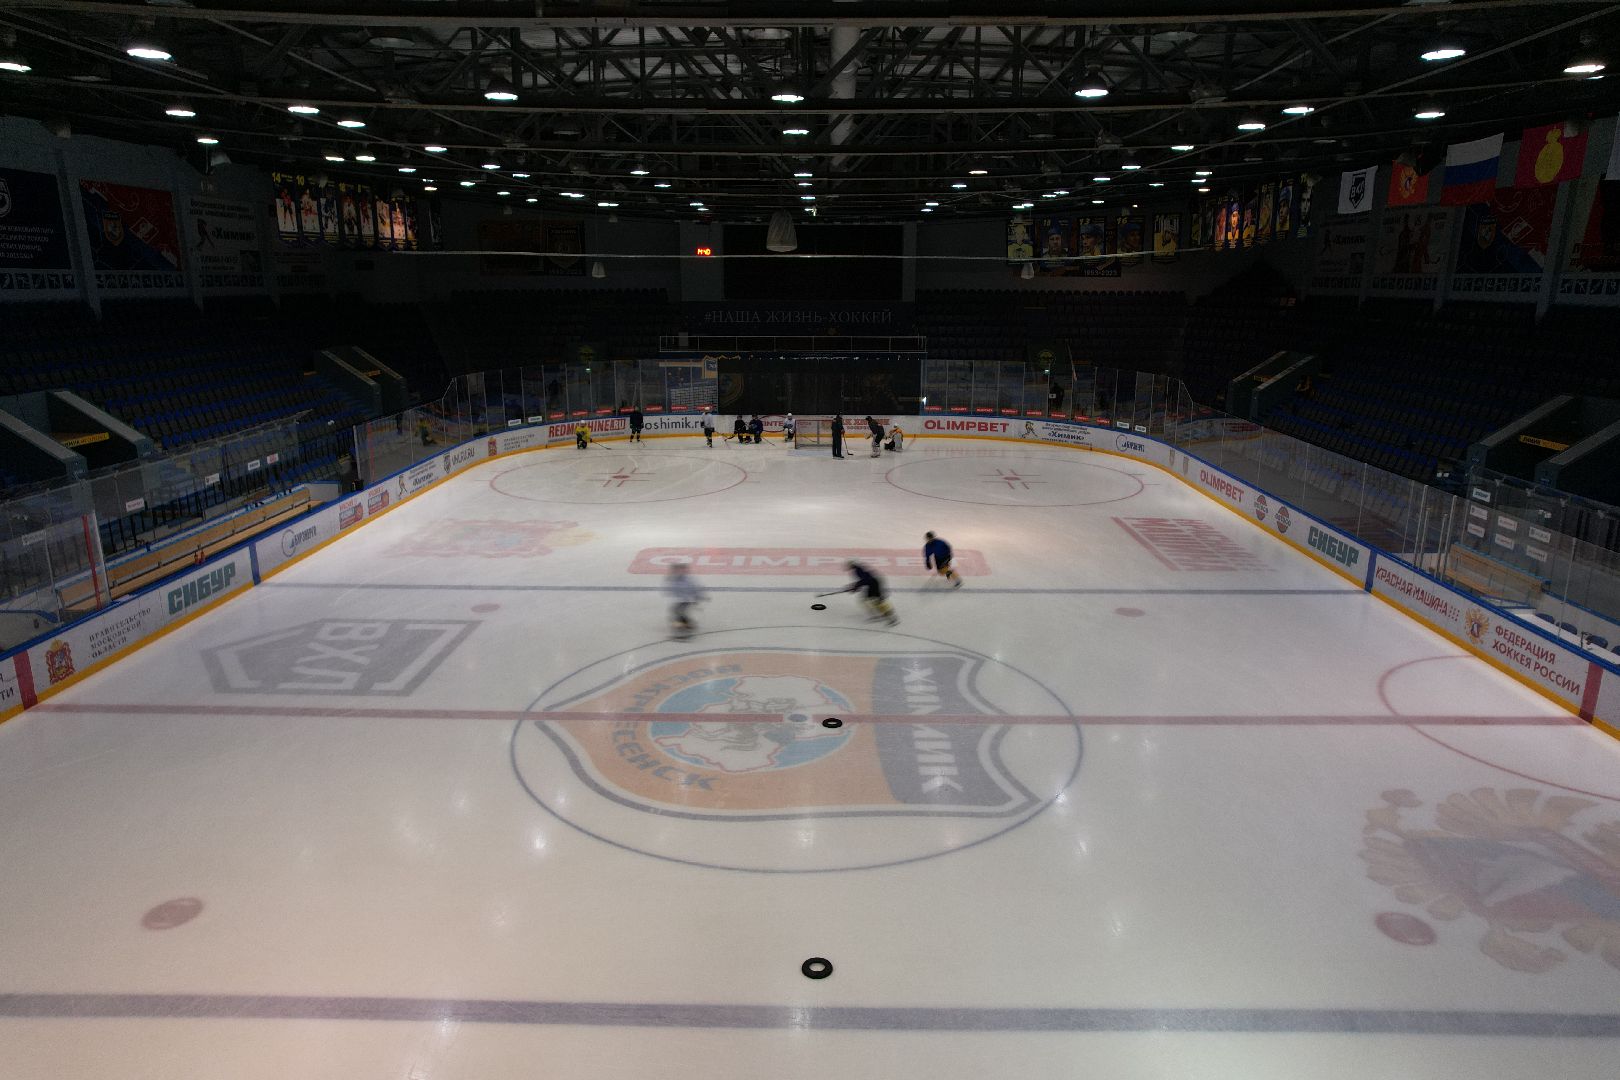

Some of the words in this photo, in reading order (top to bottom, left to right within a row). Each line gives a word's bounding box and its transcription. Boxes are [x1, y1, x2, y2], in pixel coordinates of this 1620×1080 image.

[704, 310, 760, 323] #НАША
[924, 419, 1009, 433] OLIMPBET
[1200, 470, 1245, 503] OLIMPBET
[1308, 526, 1360, 567] СИБУР
[168, 561, 236, 615] СИБУР
[1375, 566, 1413, 596] КРАСНАЯ
[1413, 586, 1449, 615] МАШИНА
[1495, 625, 1556, 665] ФЕДЕРАЦИЯ
[1492, 639, 1531, 672] ХОККЕЯ
[1533, 662, 1581, 696] РОССИИ
[901, 666, 965, 794] ХИМИК
